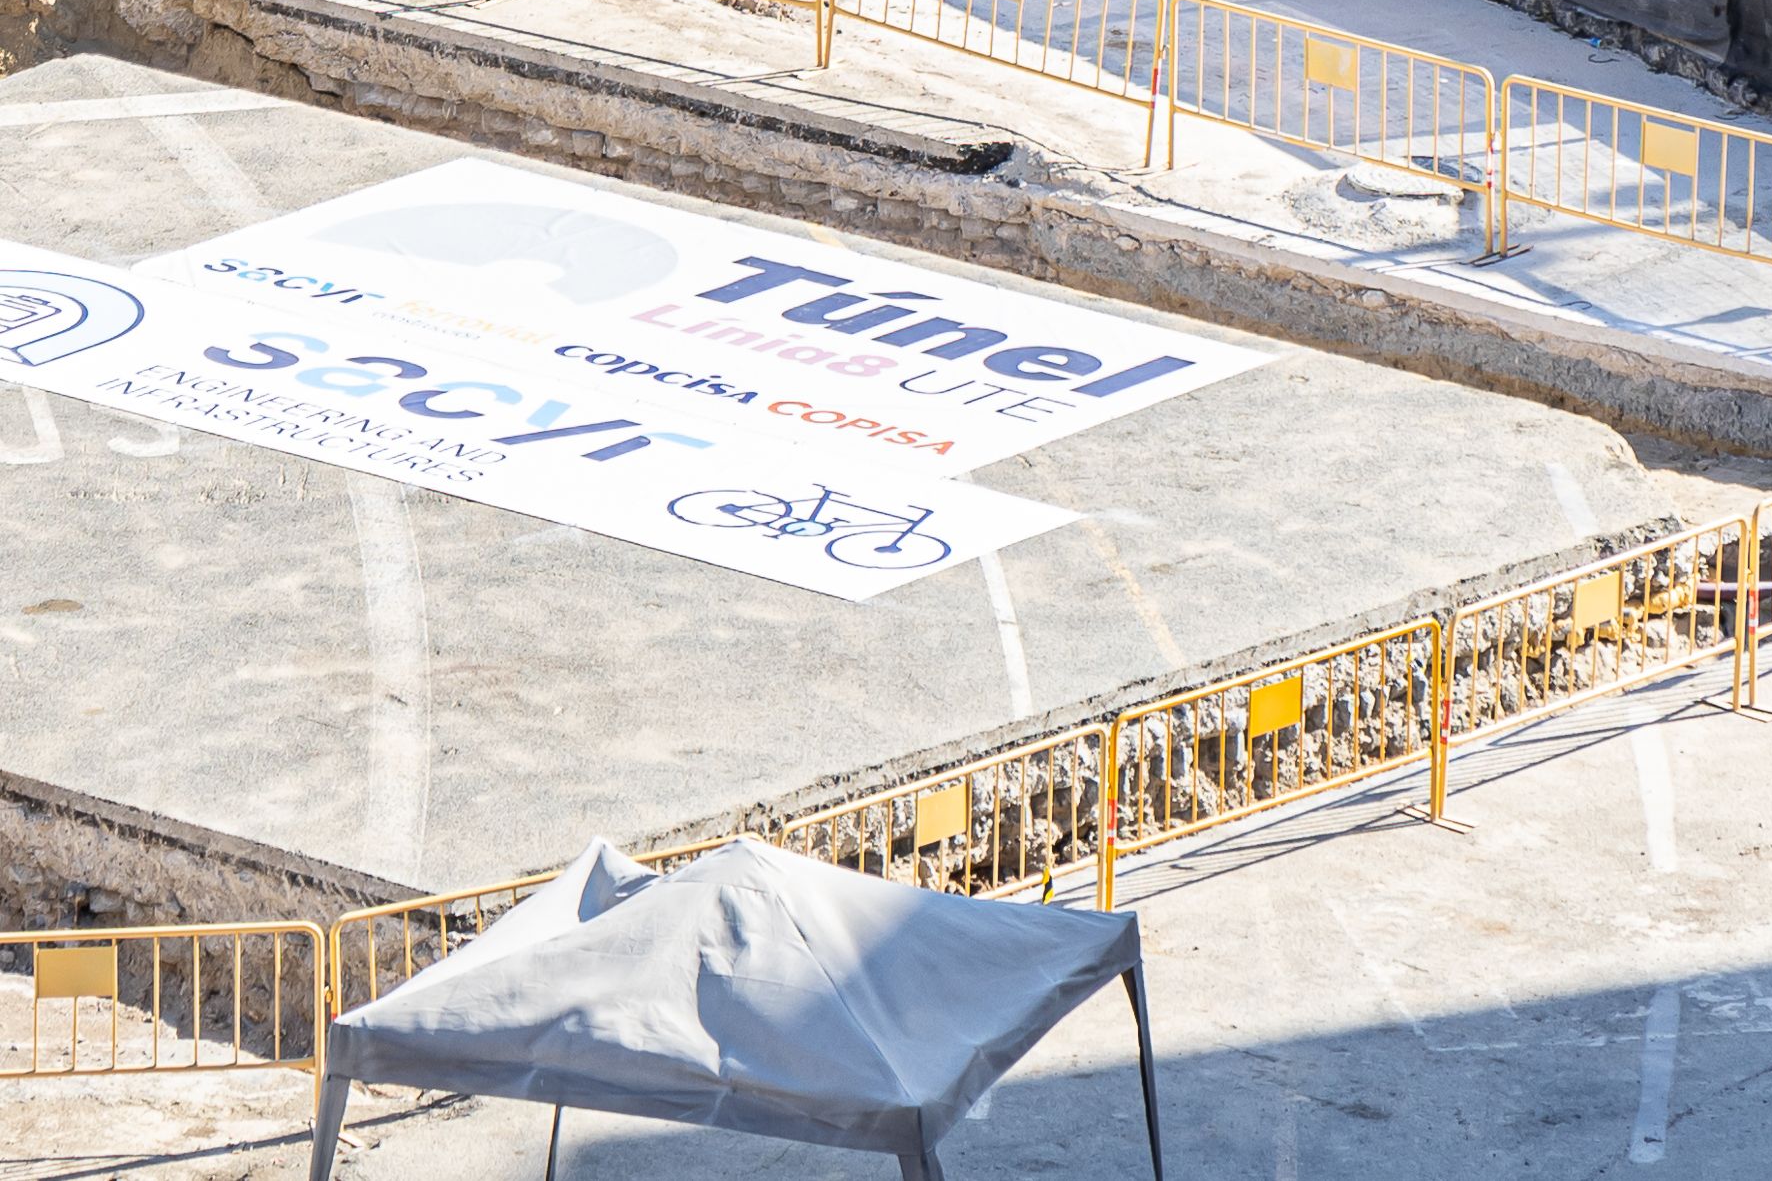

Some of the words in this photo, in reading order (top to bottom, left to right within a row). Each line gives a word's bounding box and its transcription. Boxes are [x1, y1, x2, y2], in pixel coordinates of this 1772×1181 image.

[204, 258, 385, 304] sacyr
[768, 400, 961, 456] COPISA
[696, 255, 1196, 398] Túnel
[96, 378, 485, 483] INFRASTRUCTURES
[136, 365, 413, 441] ENGINEERING
[411, 436, 507, 465] AND
